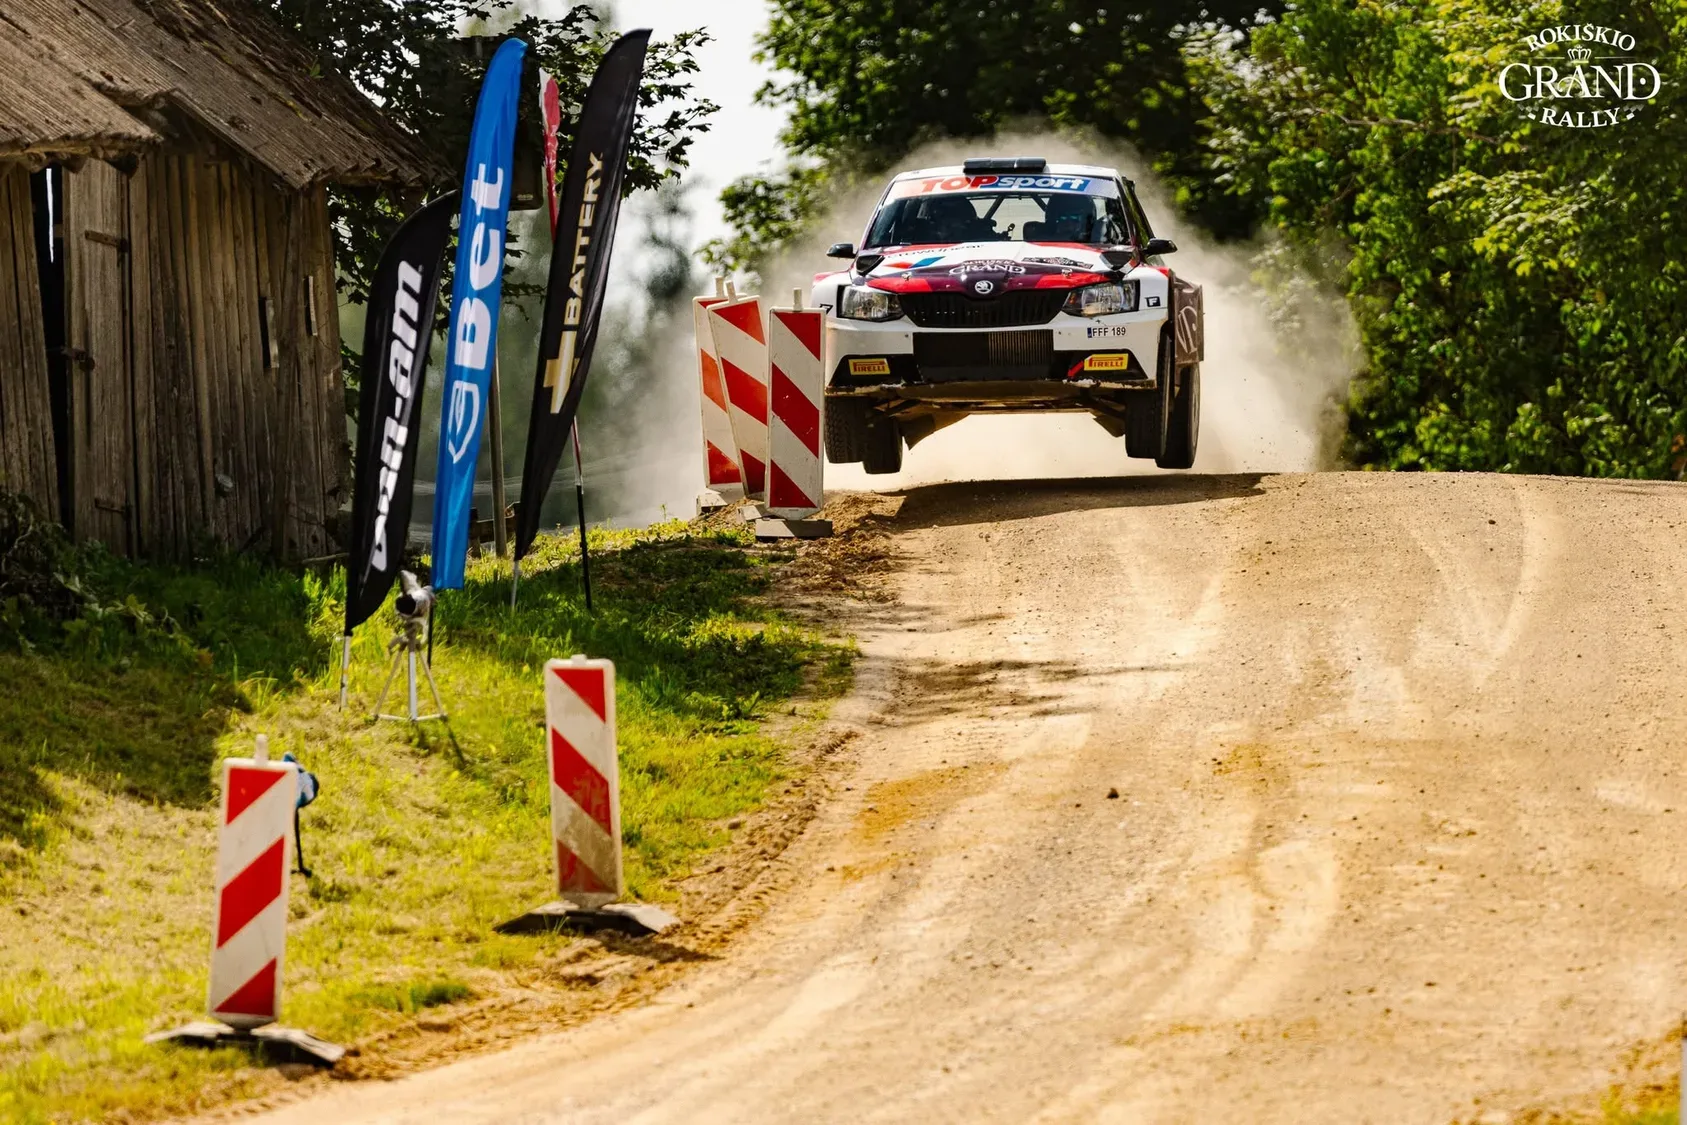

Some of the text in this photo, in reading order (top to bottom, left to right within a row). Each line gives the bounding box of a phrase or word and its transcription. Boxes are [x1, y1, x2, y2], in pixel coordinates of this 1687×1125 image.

[564, 151, 602, 325] BATTERY
[949, 264, 1026, 275] GRAND
[1092, 326, 1126, 337] FFF 189
[853, 361, 886, 372] PIRELLI
[1089, 356, 1124, 368] PIRELLI
